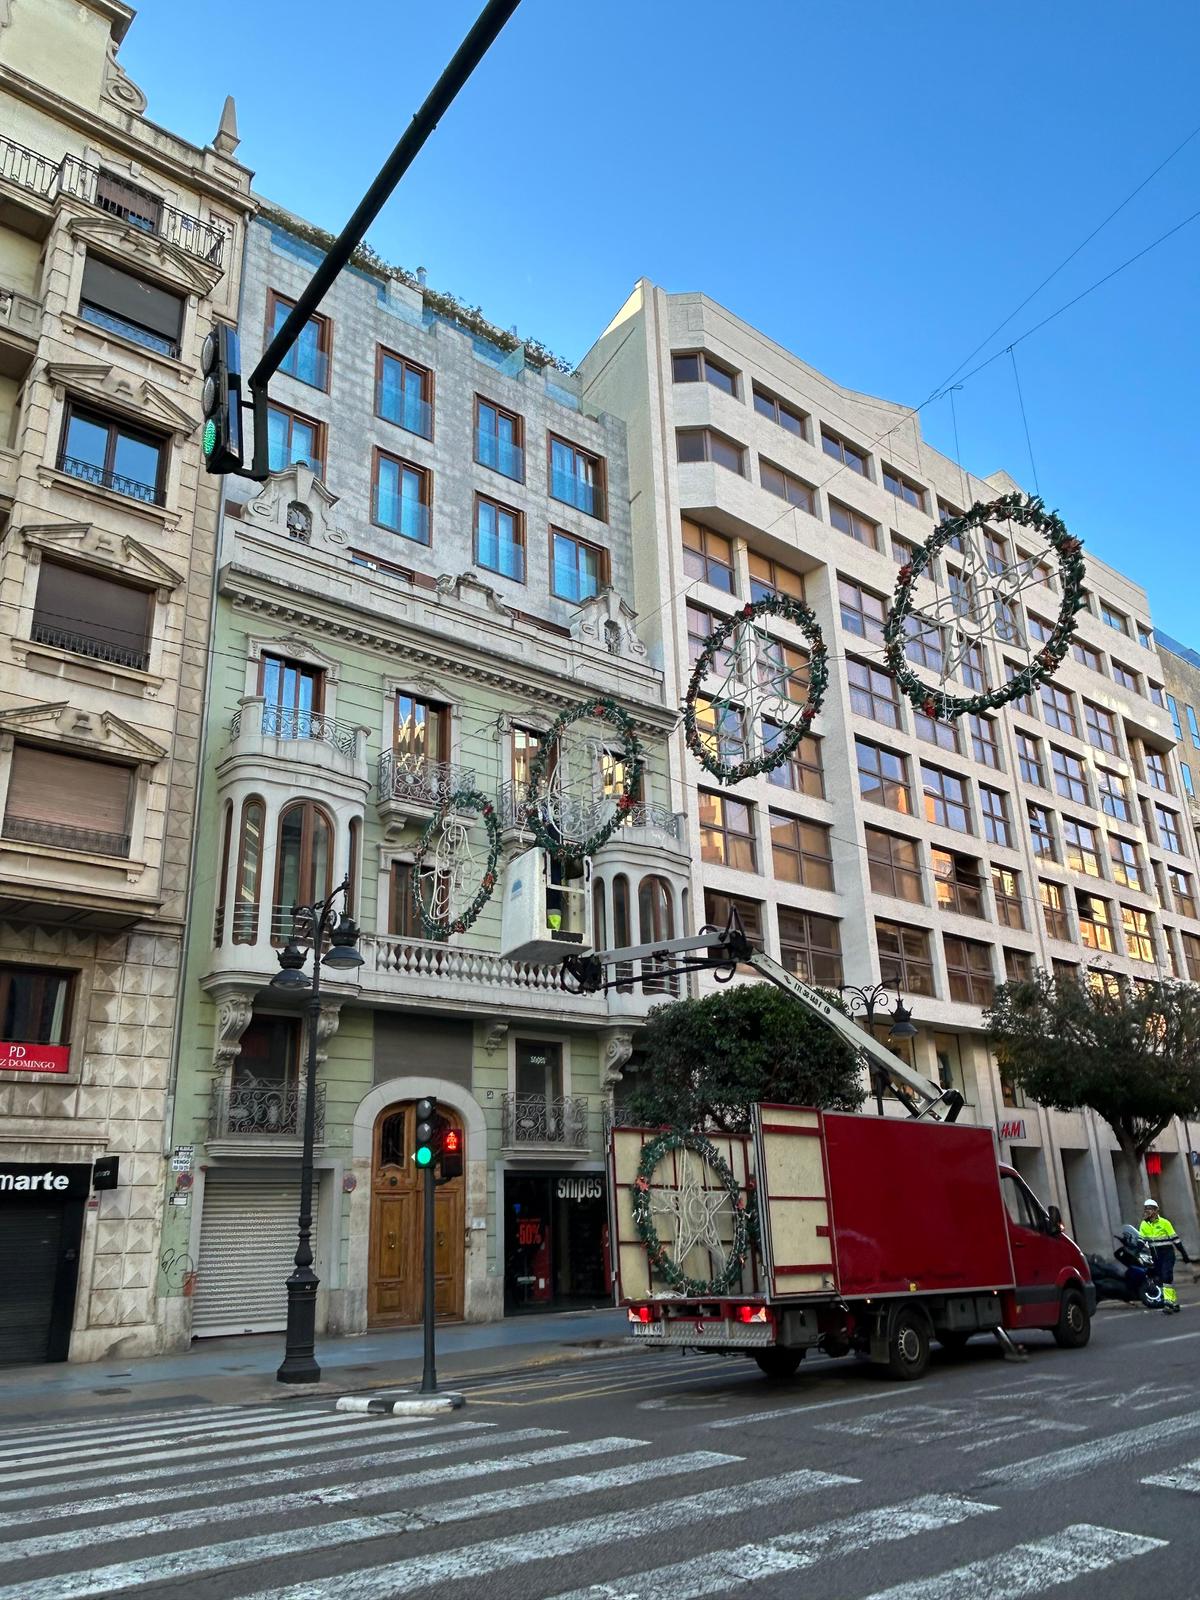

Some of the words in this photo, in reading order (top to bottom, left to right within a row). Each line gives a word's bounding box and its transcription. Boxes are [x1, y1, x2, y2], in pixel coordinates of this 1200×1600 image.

[9, 1045, 26, 1058] PD
[8, 1059, 56, 1069] DOMINGO
[0, 1171, 70, 1191] marte
[557, 1178, 602, 1203] snipes
